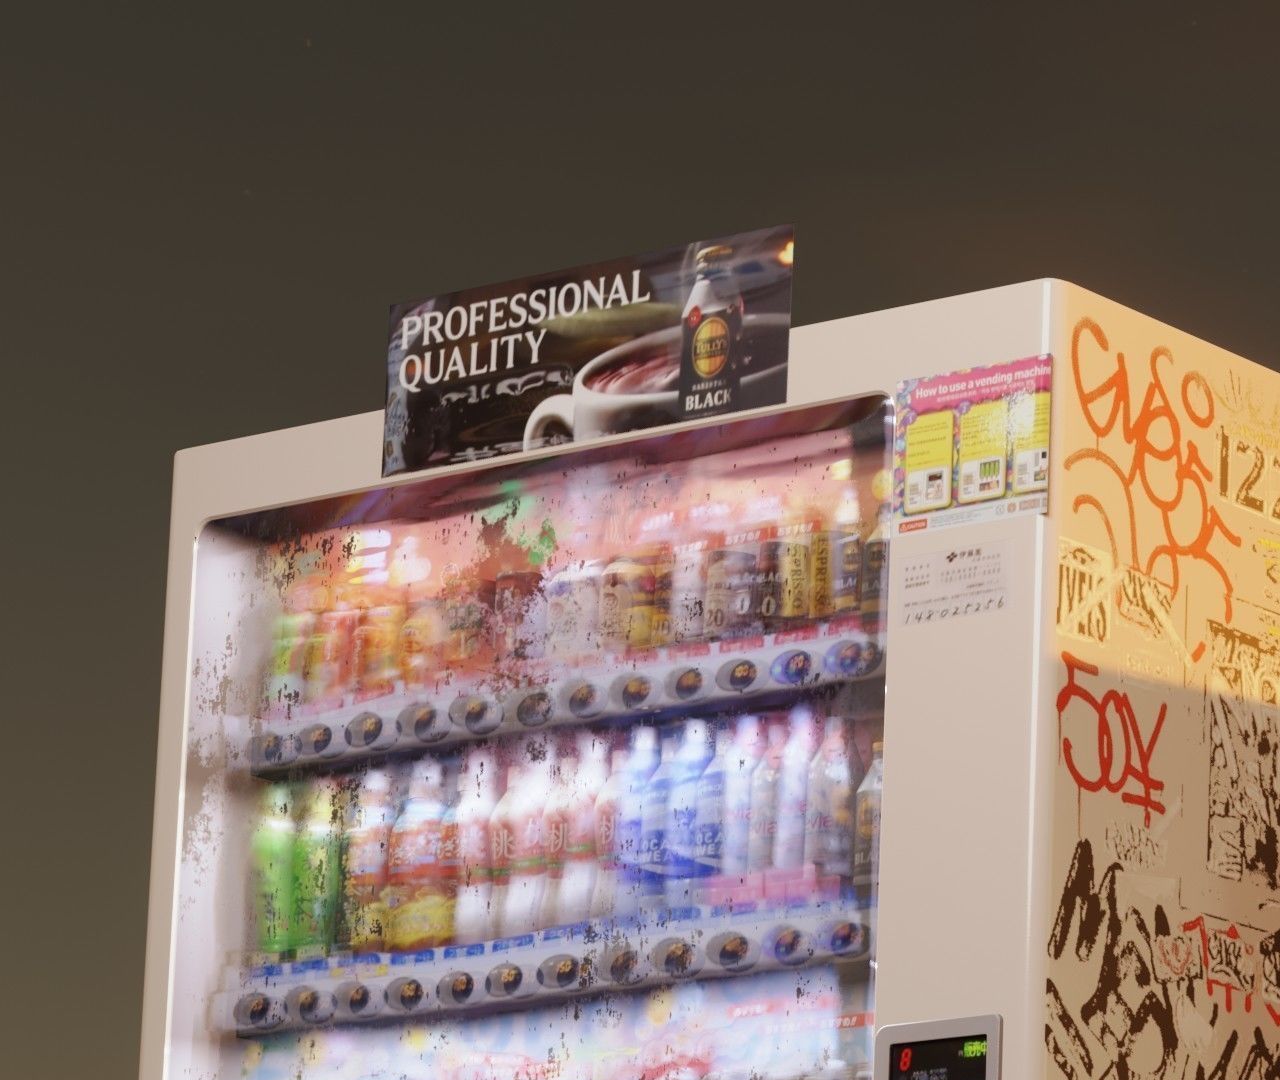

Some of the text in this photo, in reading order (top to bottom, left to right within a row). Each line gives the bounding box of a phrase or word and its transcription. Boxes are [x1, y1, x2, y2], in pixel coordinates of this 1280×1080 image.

[400, 269, 652, 350] PROFESSIONAL
[400, 328, 547, 393] QUALITY
[915, 365, 1052, 399] How to use a vending machin
[685, 387, 733, 412] BLACK
